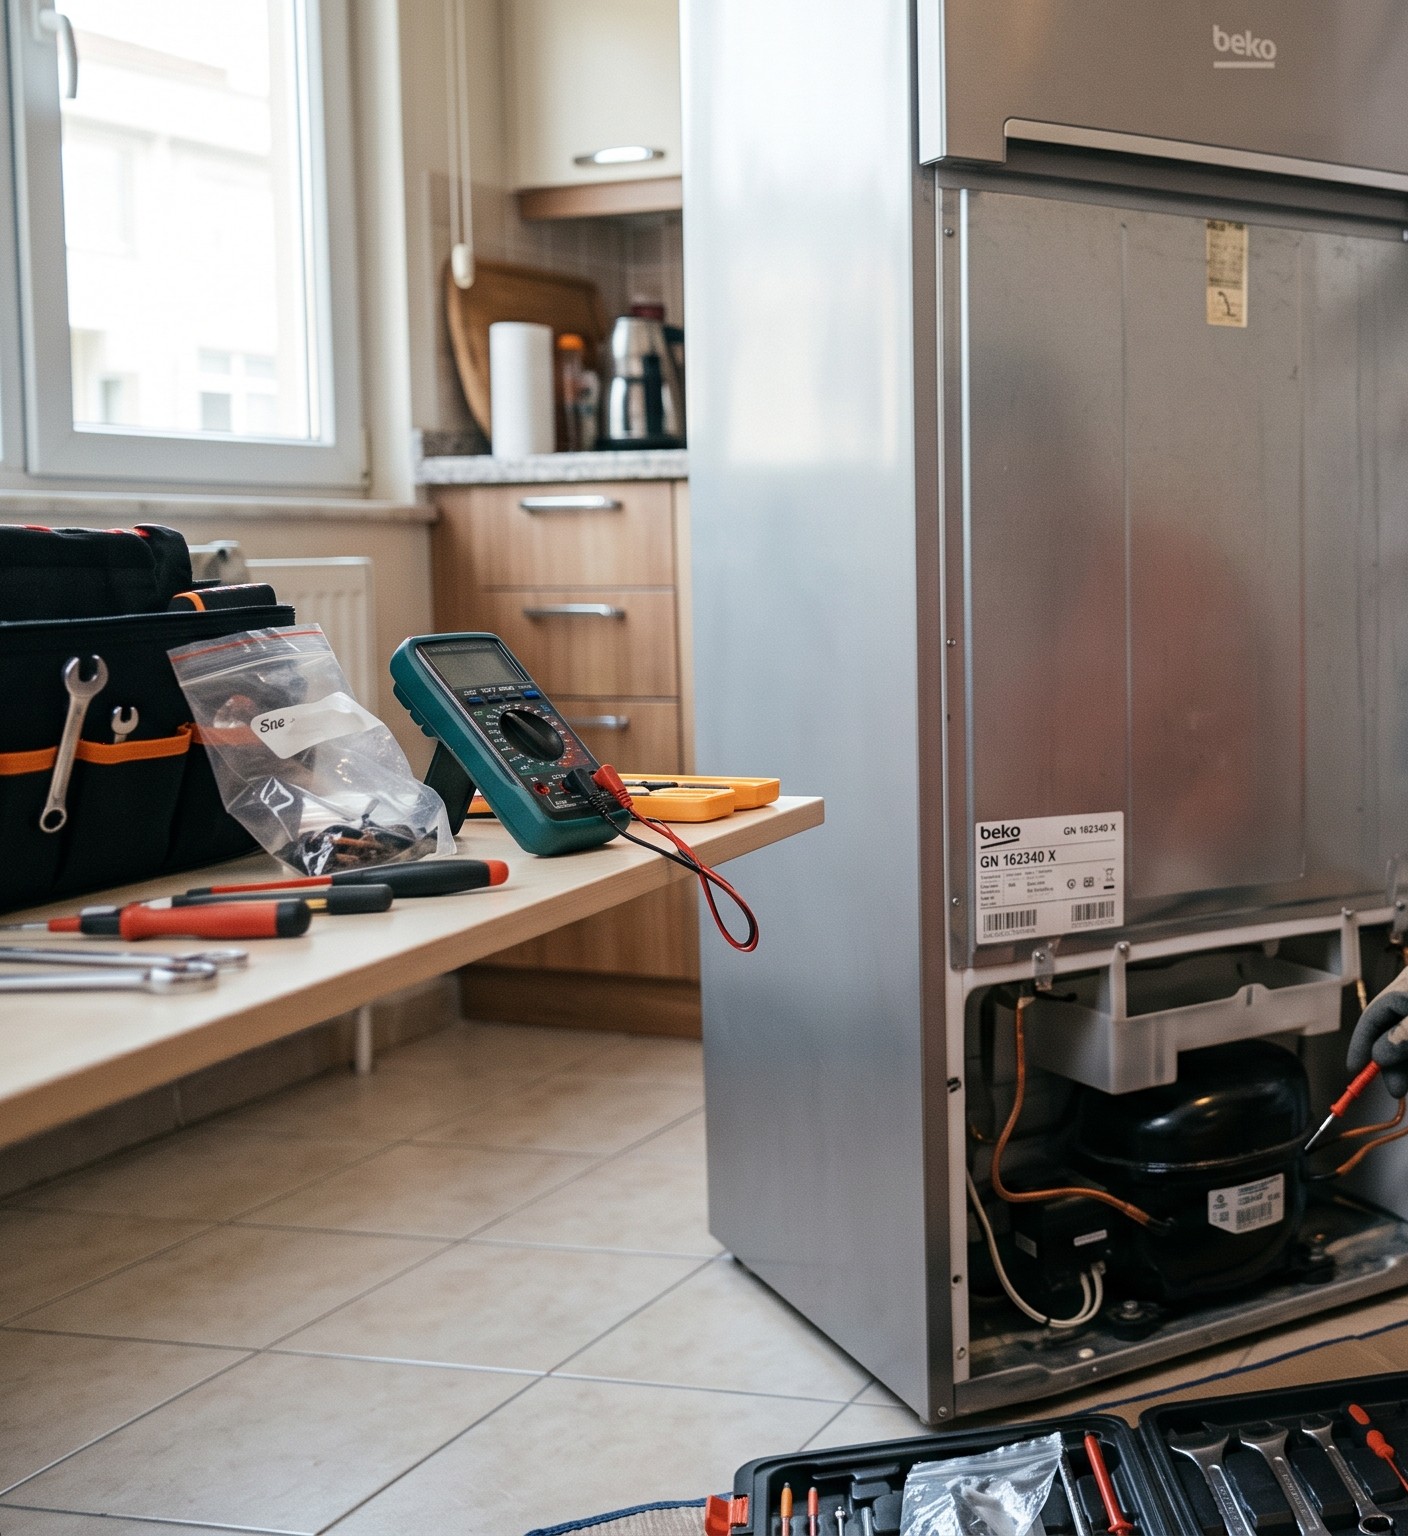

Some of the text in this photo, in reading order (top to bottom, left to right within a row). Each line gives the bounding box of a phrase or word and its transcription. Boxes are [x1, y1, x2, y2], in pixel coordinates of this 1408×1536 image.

[1213, 24, 1277, 60] beko
[980, 824, 1021, 840] beko
[1063, 826, 1077, 836] GN
[1110, 823, 1116, 832] X
[980, 850, 1056, 868] GN 162340 X
